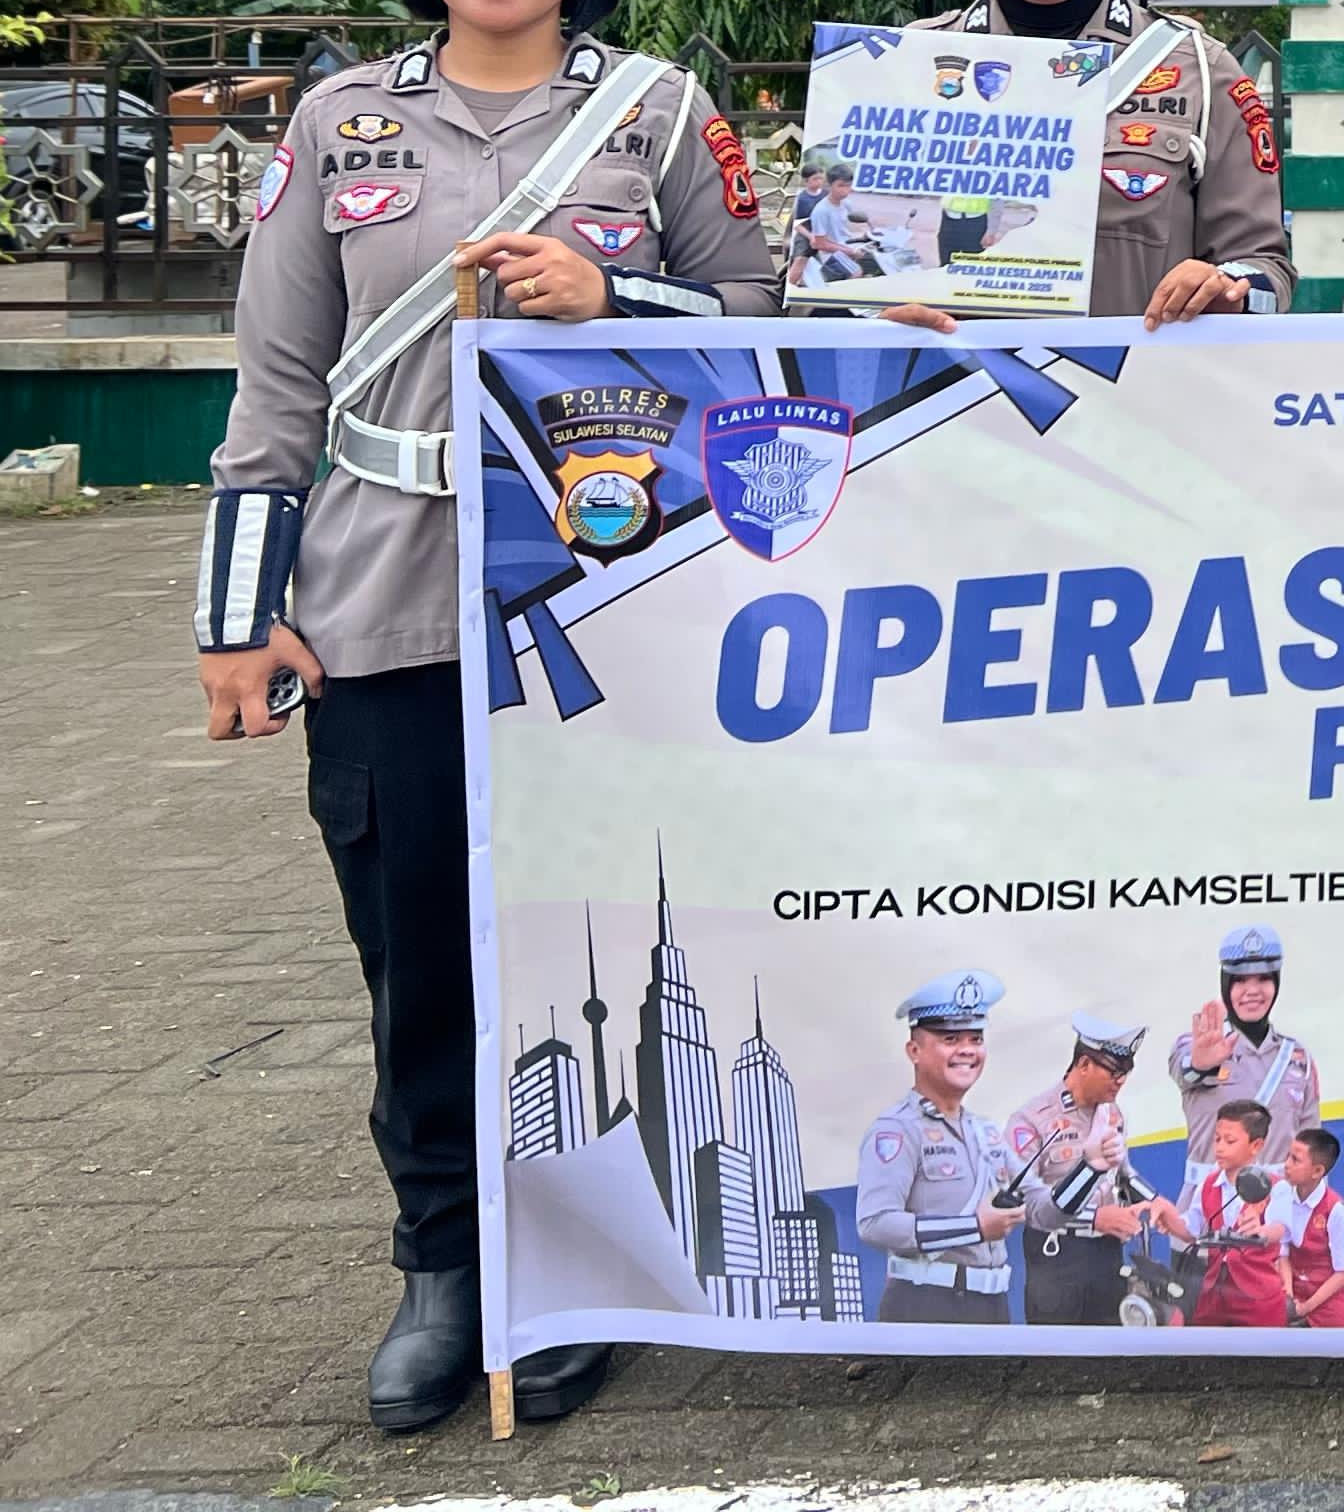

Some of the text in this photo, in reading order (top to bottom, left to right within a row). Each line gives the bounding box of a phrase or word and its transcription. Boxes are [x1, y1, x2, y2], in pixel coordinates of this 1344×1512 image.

[1115, 96, 1187, 116] OLRI
[841, 105, 1073, 142] ANAK DIBAWAH
[594, 136, 650, 159] LRI
[840, 134, 1075, 171] UMUR DILARANG
[321, 149, 424, 177] ADEL
[855, 164, 1051, 199] BERKENDARA
[561, 389, 669, 408] POLRES
[565, 403, 660, 418] PINRANG
[717, 405, 841, 426] LALU LINTAS
[553, 423, 669, 444] SULAWESI SELATAN
[772, 888, 903, 921] CIPTA
[916, 879, 1096, 917] KONDISI
